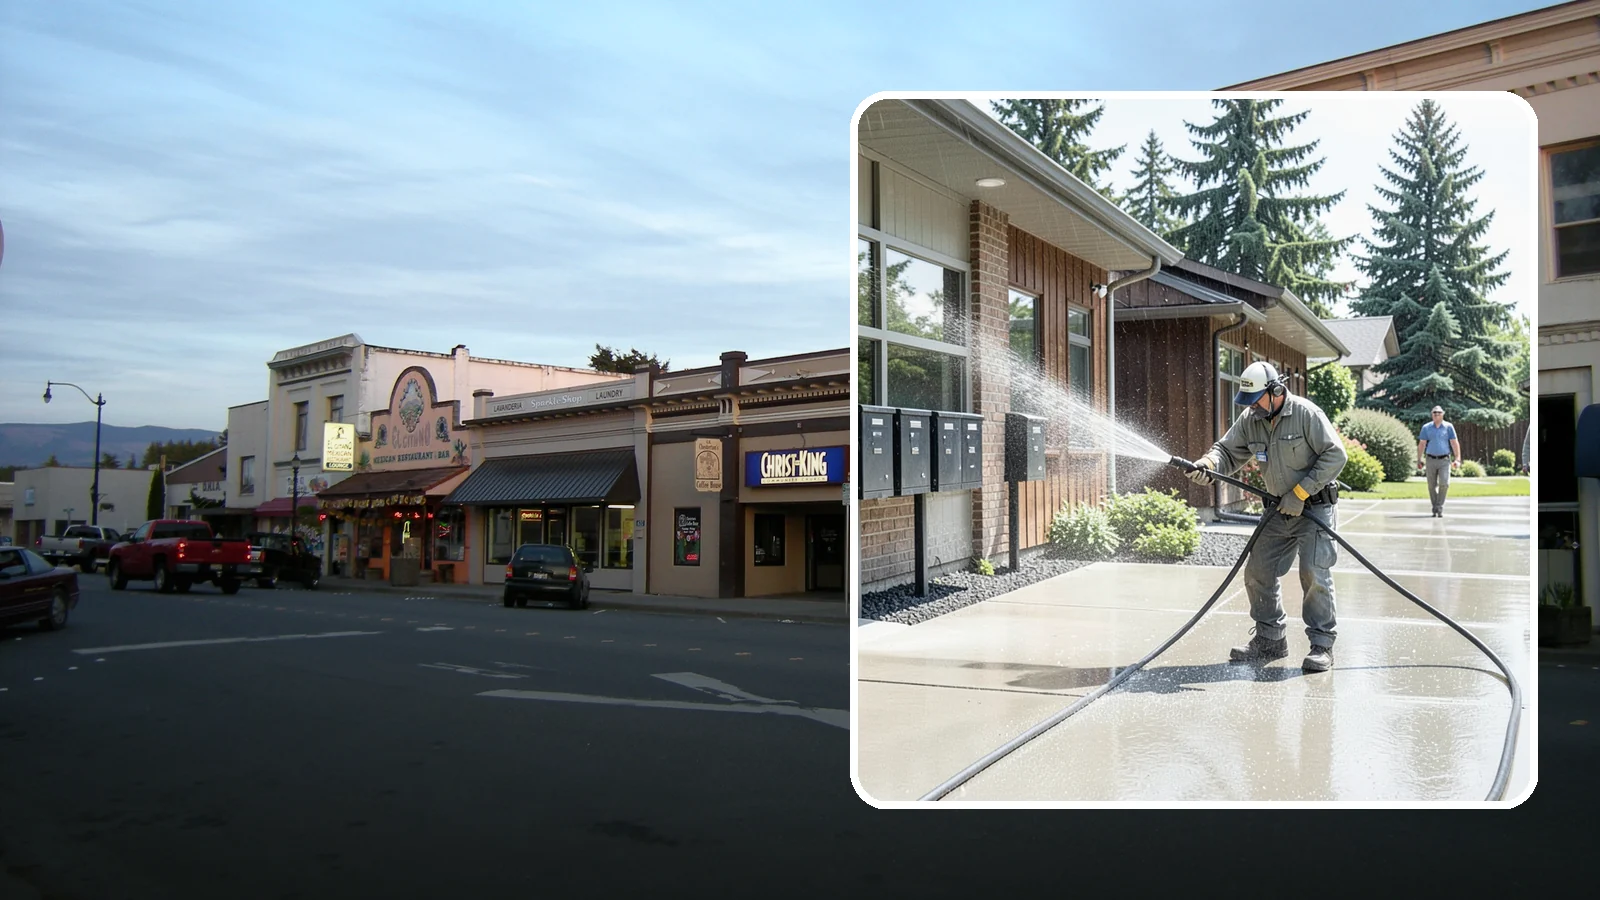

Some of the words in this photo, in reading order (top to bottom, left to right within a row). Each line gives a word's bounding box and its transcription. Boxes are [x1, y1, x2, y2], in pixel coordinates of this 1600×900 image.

[531, 398, 560, 409] Sparkle
[562, 394, 582, 404] Shop
[596, 389, 623, 400] LAUNDRY
[494, 402, 522, 412] LAVANDERIA
[374, 454, 396, 464] MEXICAN
[398, 452, 433, 462] RESTAURANT
[438, 450, 450, 458] BAR
[761, 452, 797, 478] CHRIST
[800, 450, 827, 476] KING
